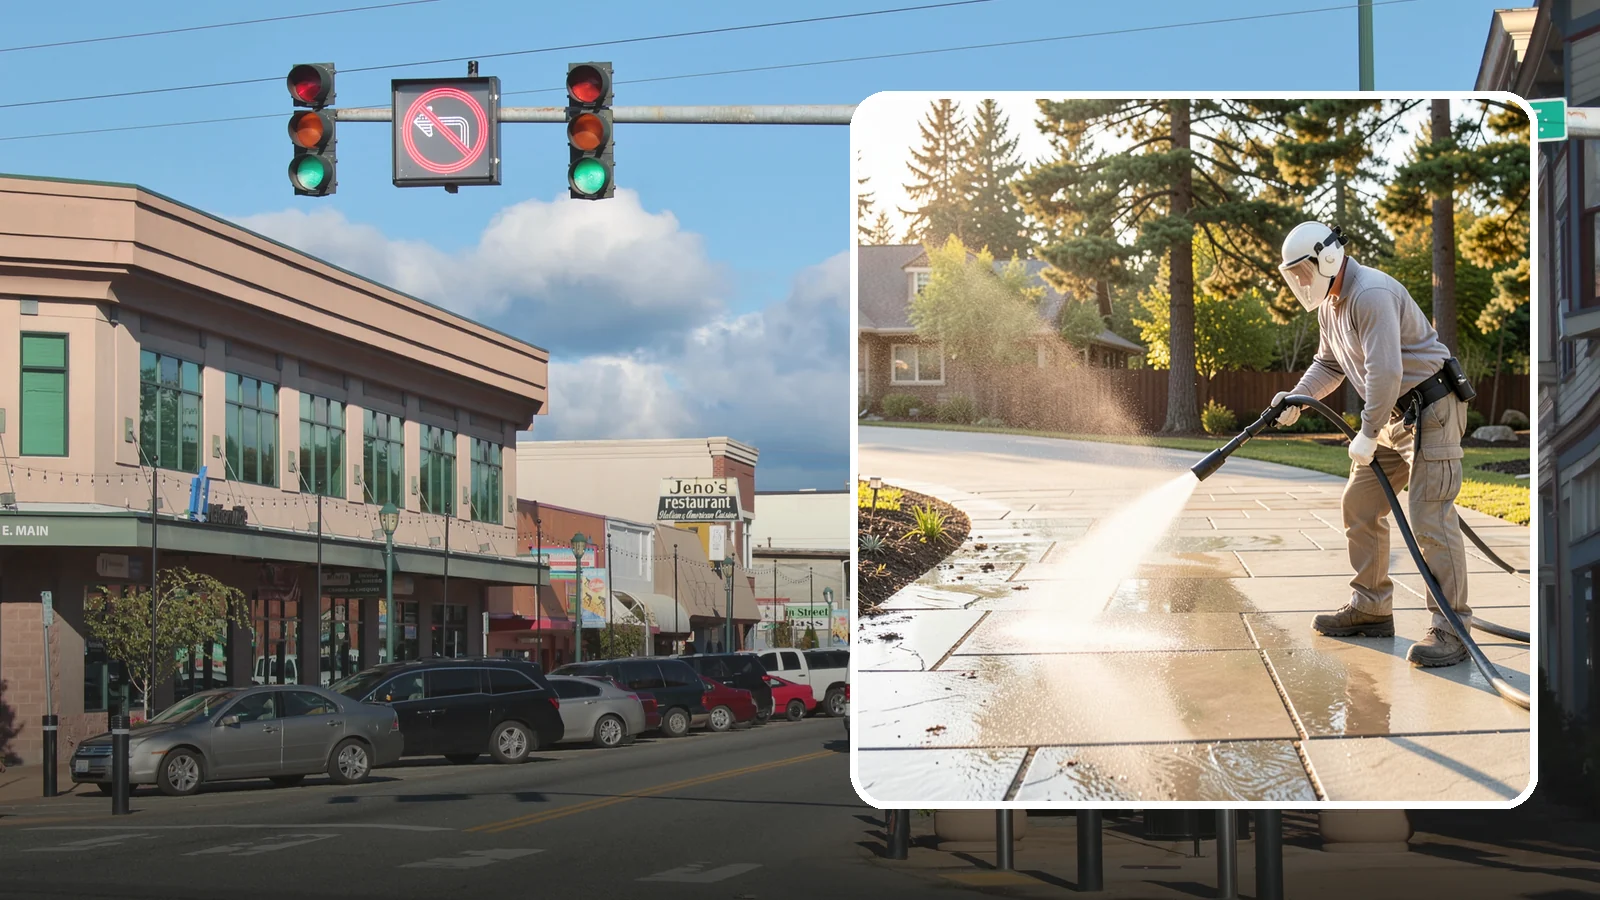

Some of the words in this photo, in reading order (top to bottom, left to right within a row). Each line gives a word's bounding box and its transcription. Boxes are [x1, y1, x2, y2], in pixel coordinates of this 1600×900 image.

[669, 480, 727, 495] Jeno's
[664, 496, 731, 509] restaurant
[658, 510, 681, 519] Italian
[686, 509, 714, 519] American
[714, 509, 738, 520] Cuisine
[2, 525, 13, 536] E.
[15, 525, 49, 536] MAIN
[797, 607, 828, 617] Street
